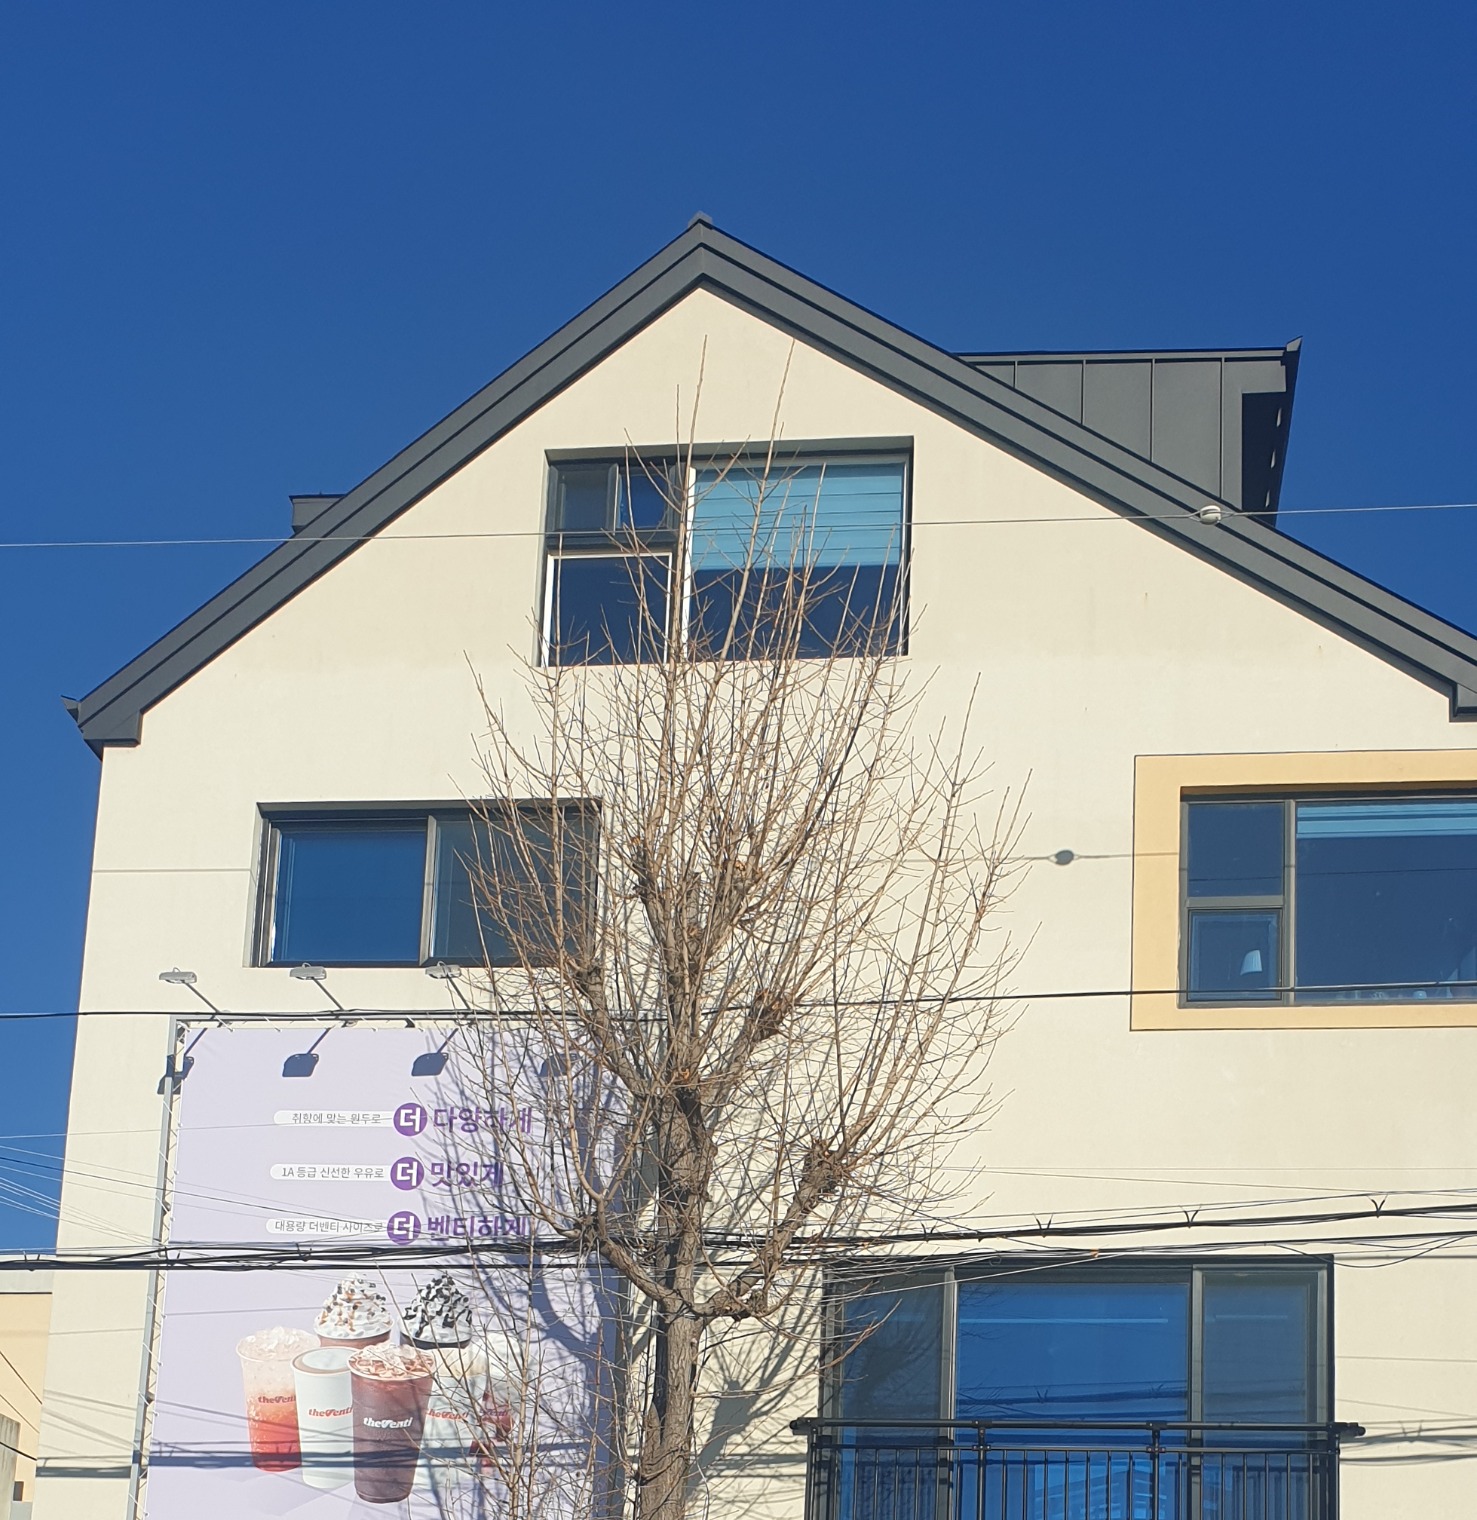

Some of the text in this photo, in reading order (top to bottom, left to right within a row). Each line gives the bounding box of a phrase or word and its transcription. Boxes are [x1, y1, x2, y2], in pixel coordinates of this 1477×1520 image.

[326, 1112, 347, 1125] 맞는
[350, 1113, 382, 1124] 원두로
[400, 1107, 421, 1132] 더
[281, 1161, 504, 1188] 1A 등급 신선한 우유로 더 맛있게
[274, 1220, 306, 1232] 대용량
[309, 1221, 340, 1233] 더벤티
[393, 1215, 415, 1240] 더
[363, 1416, 414, 1430] theVenti
